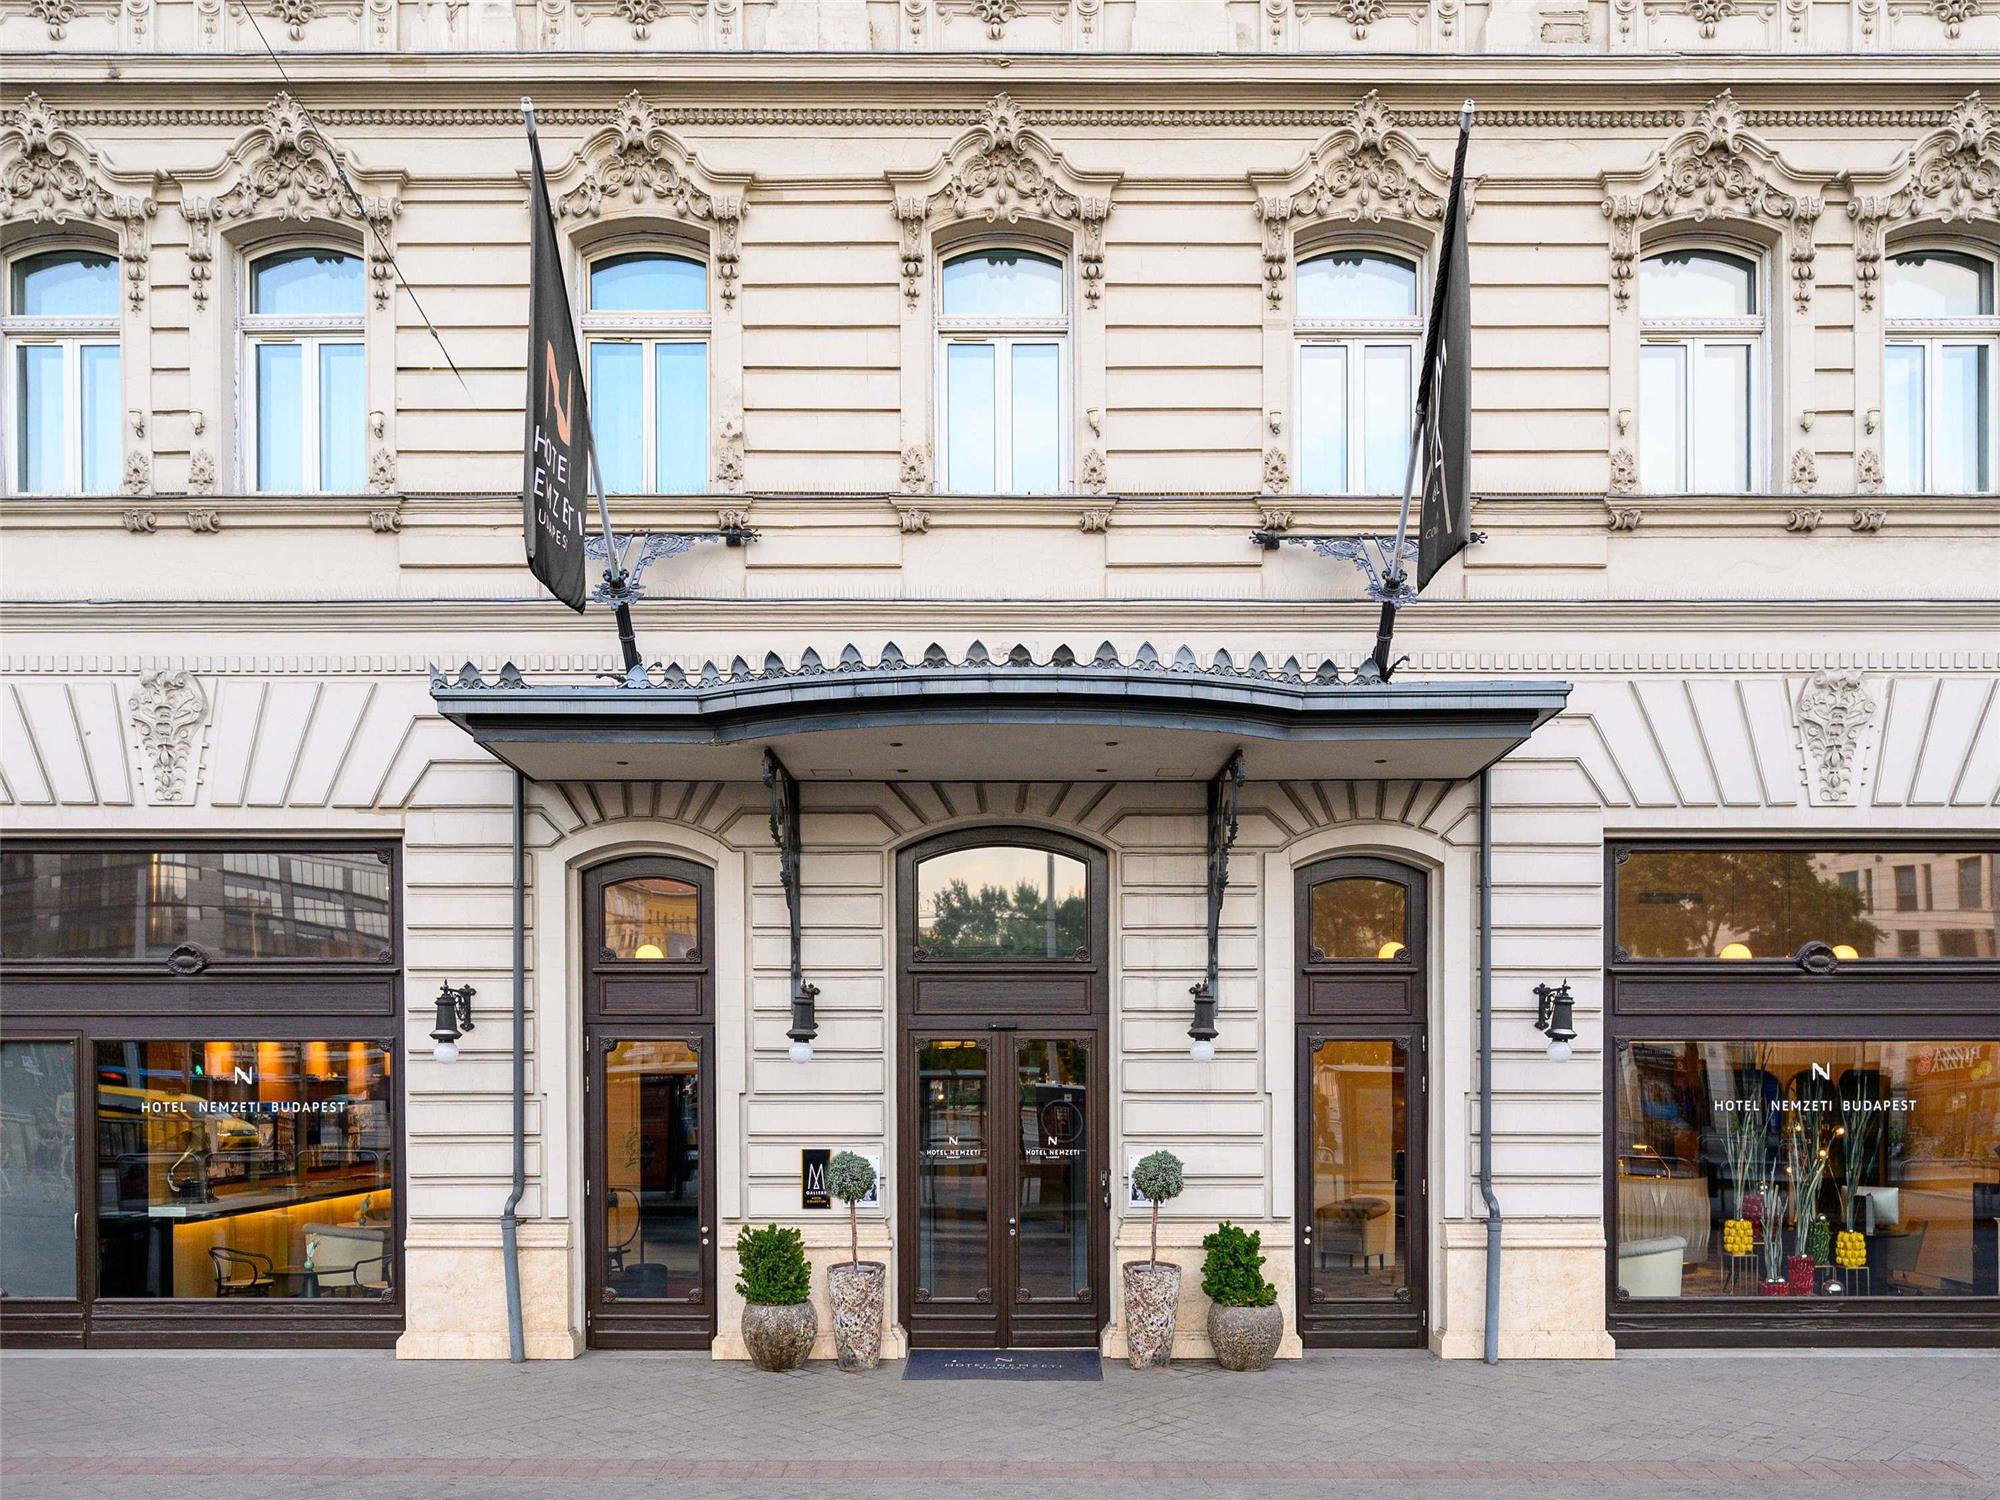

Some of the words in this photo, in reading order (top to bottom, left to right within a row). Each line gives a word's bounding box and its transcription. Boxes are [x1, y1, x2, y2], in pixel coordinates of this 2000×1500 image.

[234, 1066, 253, 1085] N
[1812, 1062, 1831, 1081] N
[141, 1101, 187, 1113] HOTEL
[198, 1101, 260, 1113] NEMZETI
[271, 1101, 346, 1113] BUDAPEST
[1714, 1100, 1760, 1112] HOTEL
[1771, 1100, 1833, 1112] NEMZETI
[1843, 1100, 1917, 1112] BUDAPEST
[948, 1136, 959, 1145] N
[1048, 1136, 1058, 1145] N
